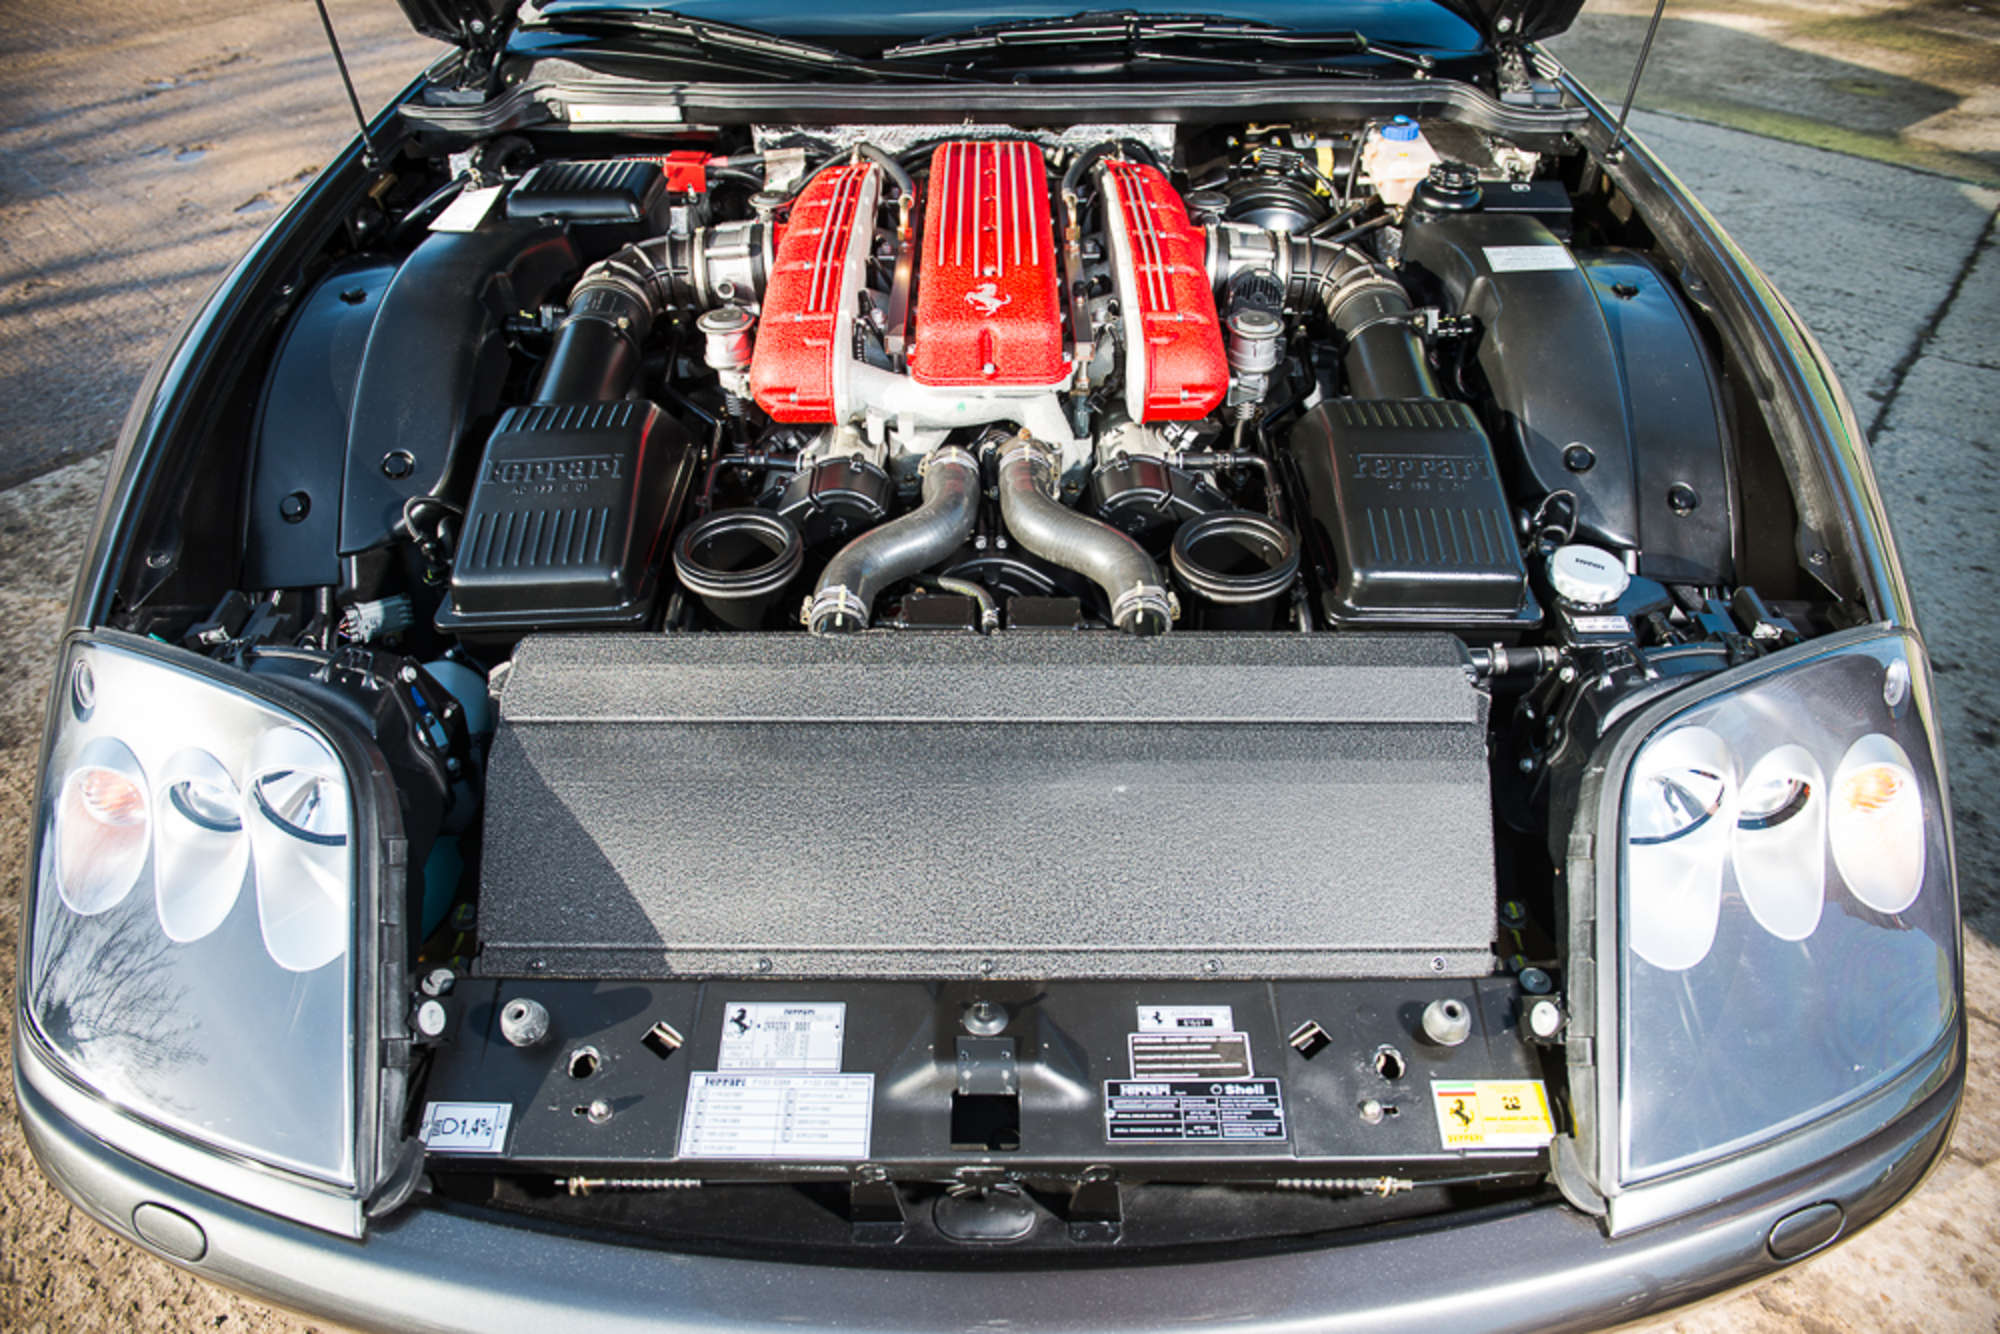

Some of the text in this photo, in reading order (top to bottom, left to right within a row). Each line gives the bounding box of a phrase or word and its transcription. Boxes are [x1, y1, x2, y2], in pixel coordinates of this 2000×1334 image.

[481, 453, 624, 484] Ferrari
[1352, 453, 1493, 481] Ferrari
[705, 1076, 746, 1087] Ferrari
[1120, 1084, 1171, 1096] Ferrari
[1224, 1083, 1265, 1095] Shell
